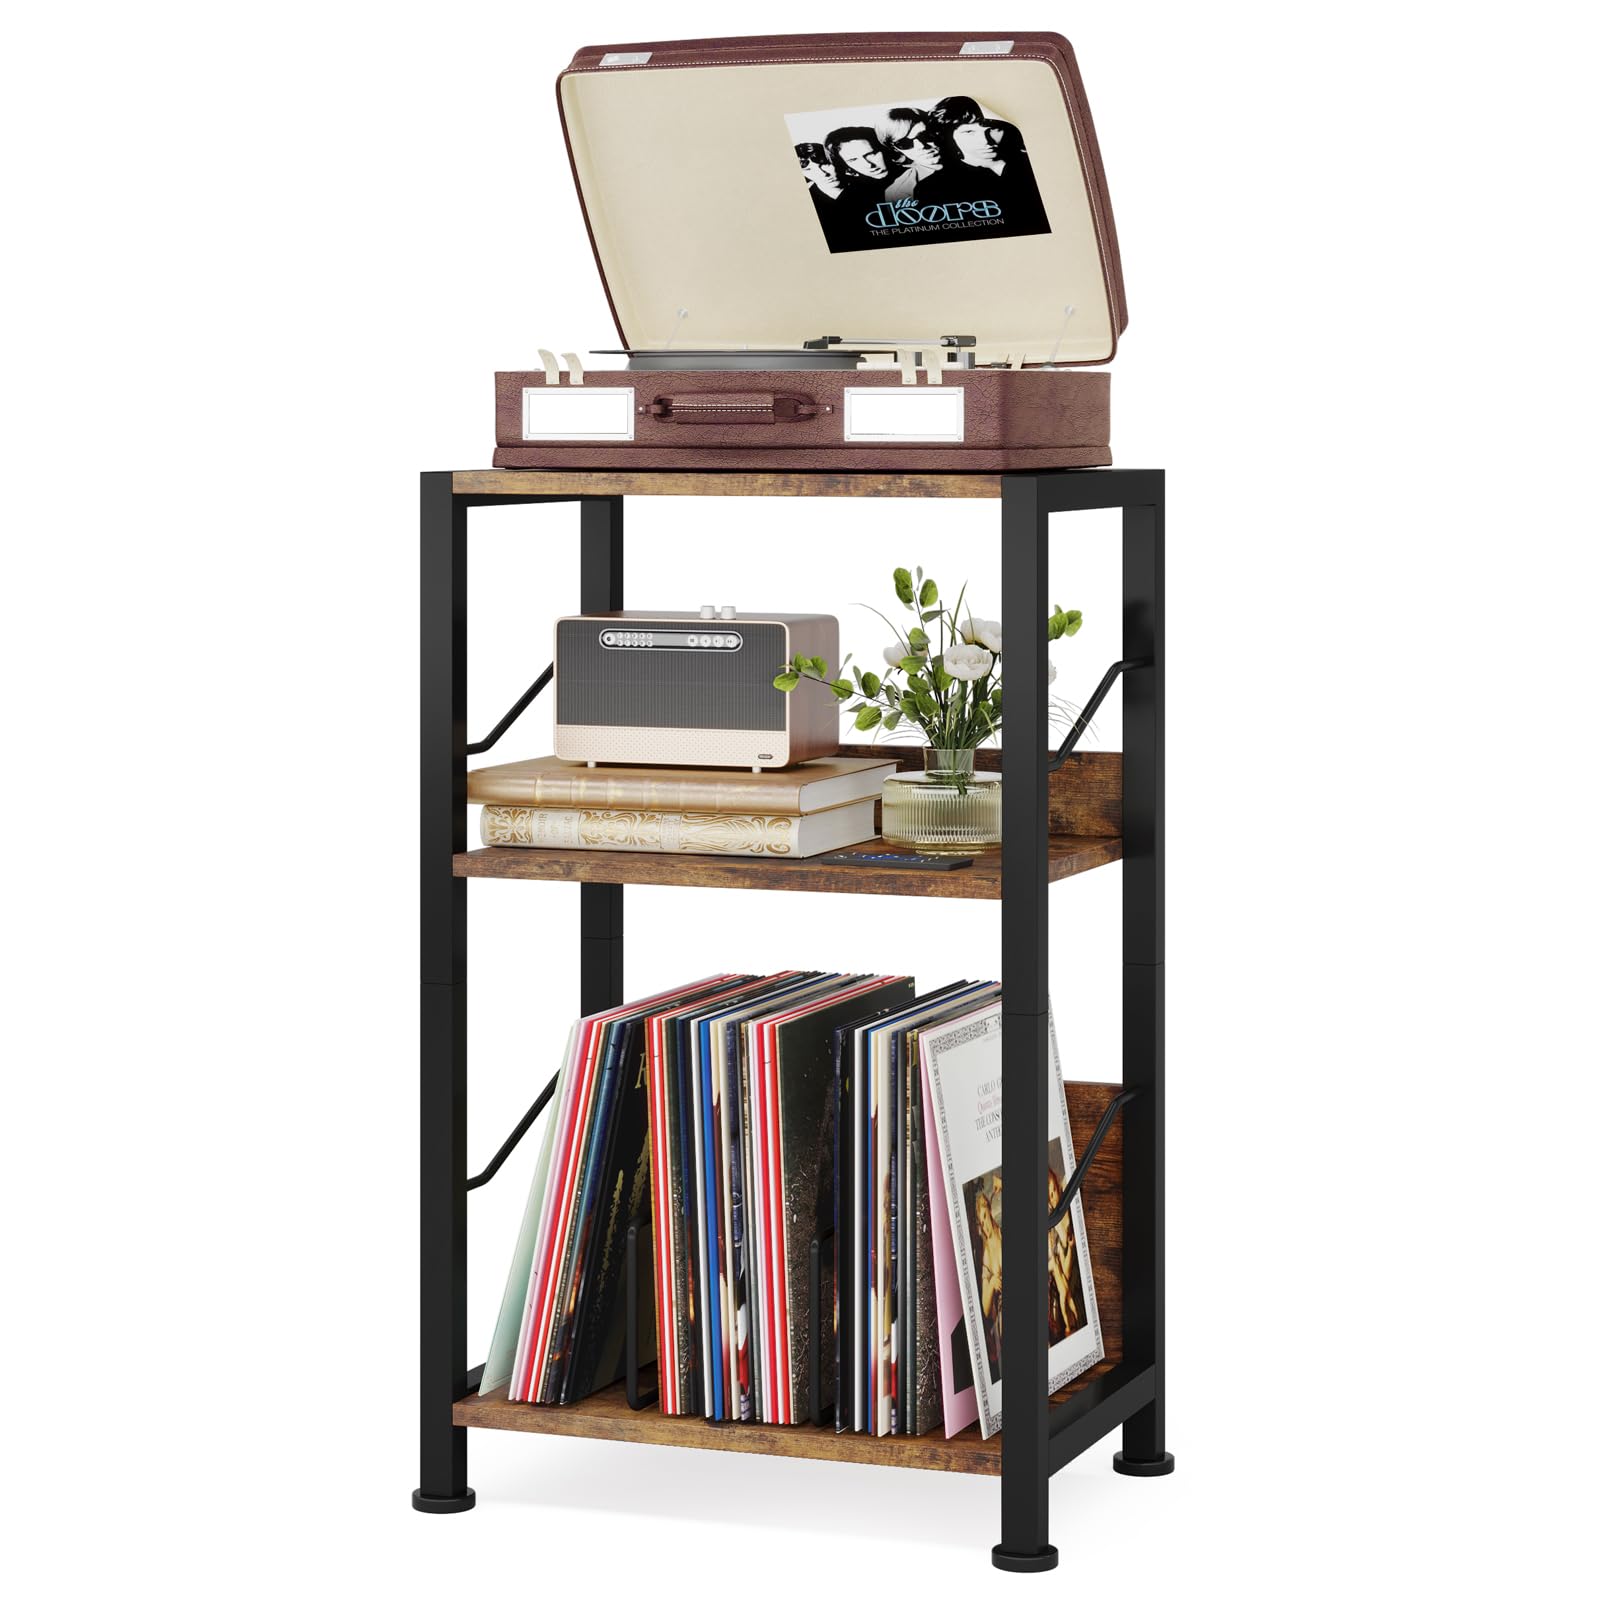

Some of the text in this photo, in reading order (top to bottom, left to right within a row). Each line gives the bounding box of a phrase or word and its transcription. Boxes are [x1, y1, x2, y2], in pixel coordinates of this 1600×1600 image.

[895, 196, 919, 208] the
[865, 200, 1002, 228] doors
[869, 218, 1005, 236] THE PLATINUM COLLECTION
[977, 1080, 996, 1097] CARLO
